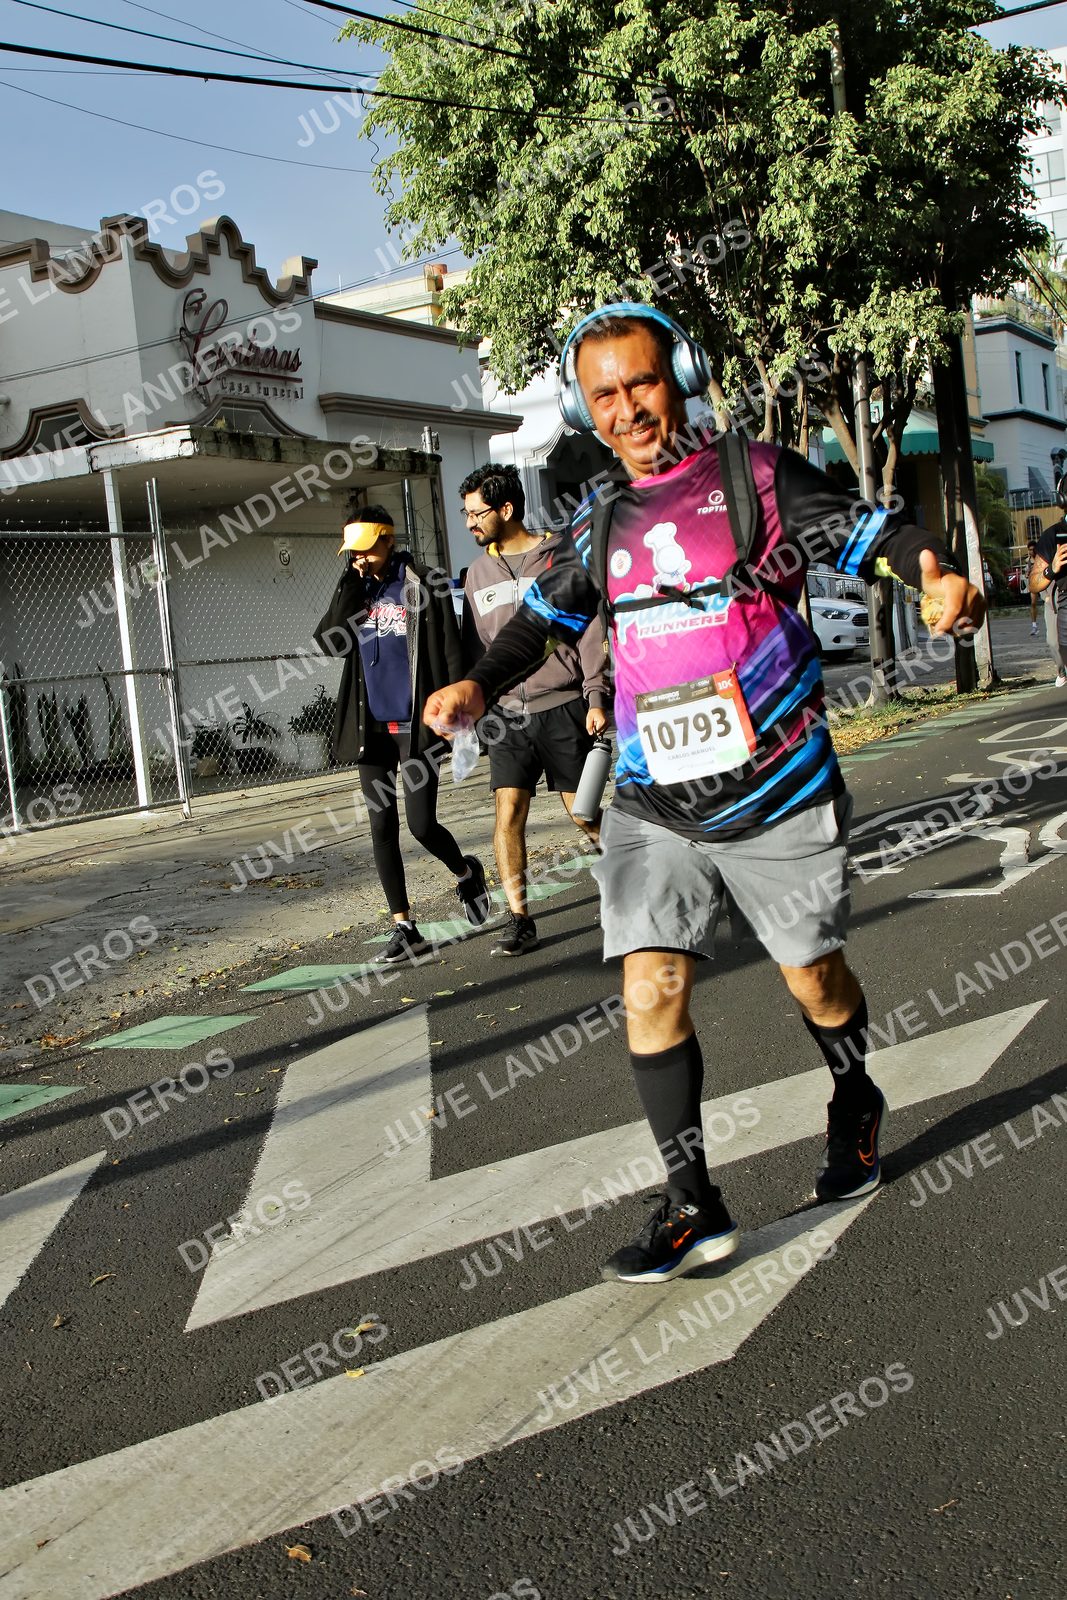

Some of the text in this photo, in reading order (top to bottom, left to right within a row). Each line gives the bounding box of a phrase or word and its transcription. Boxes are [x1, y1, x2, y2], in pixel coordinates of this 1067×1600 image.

[256, 381, 304, 400] Funeral
[640, 612, 727, 637] RUNNERS
[717, 679, 733, 691] 10K
[643, 707, 732, 753] 10793
